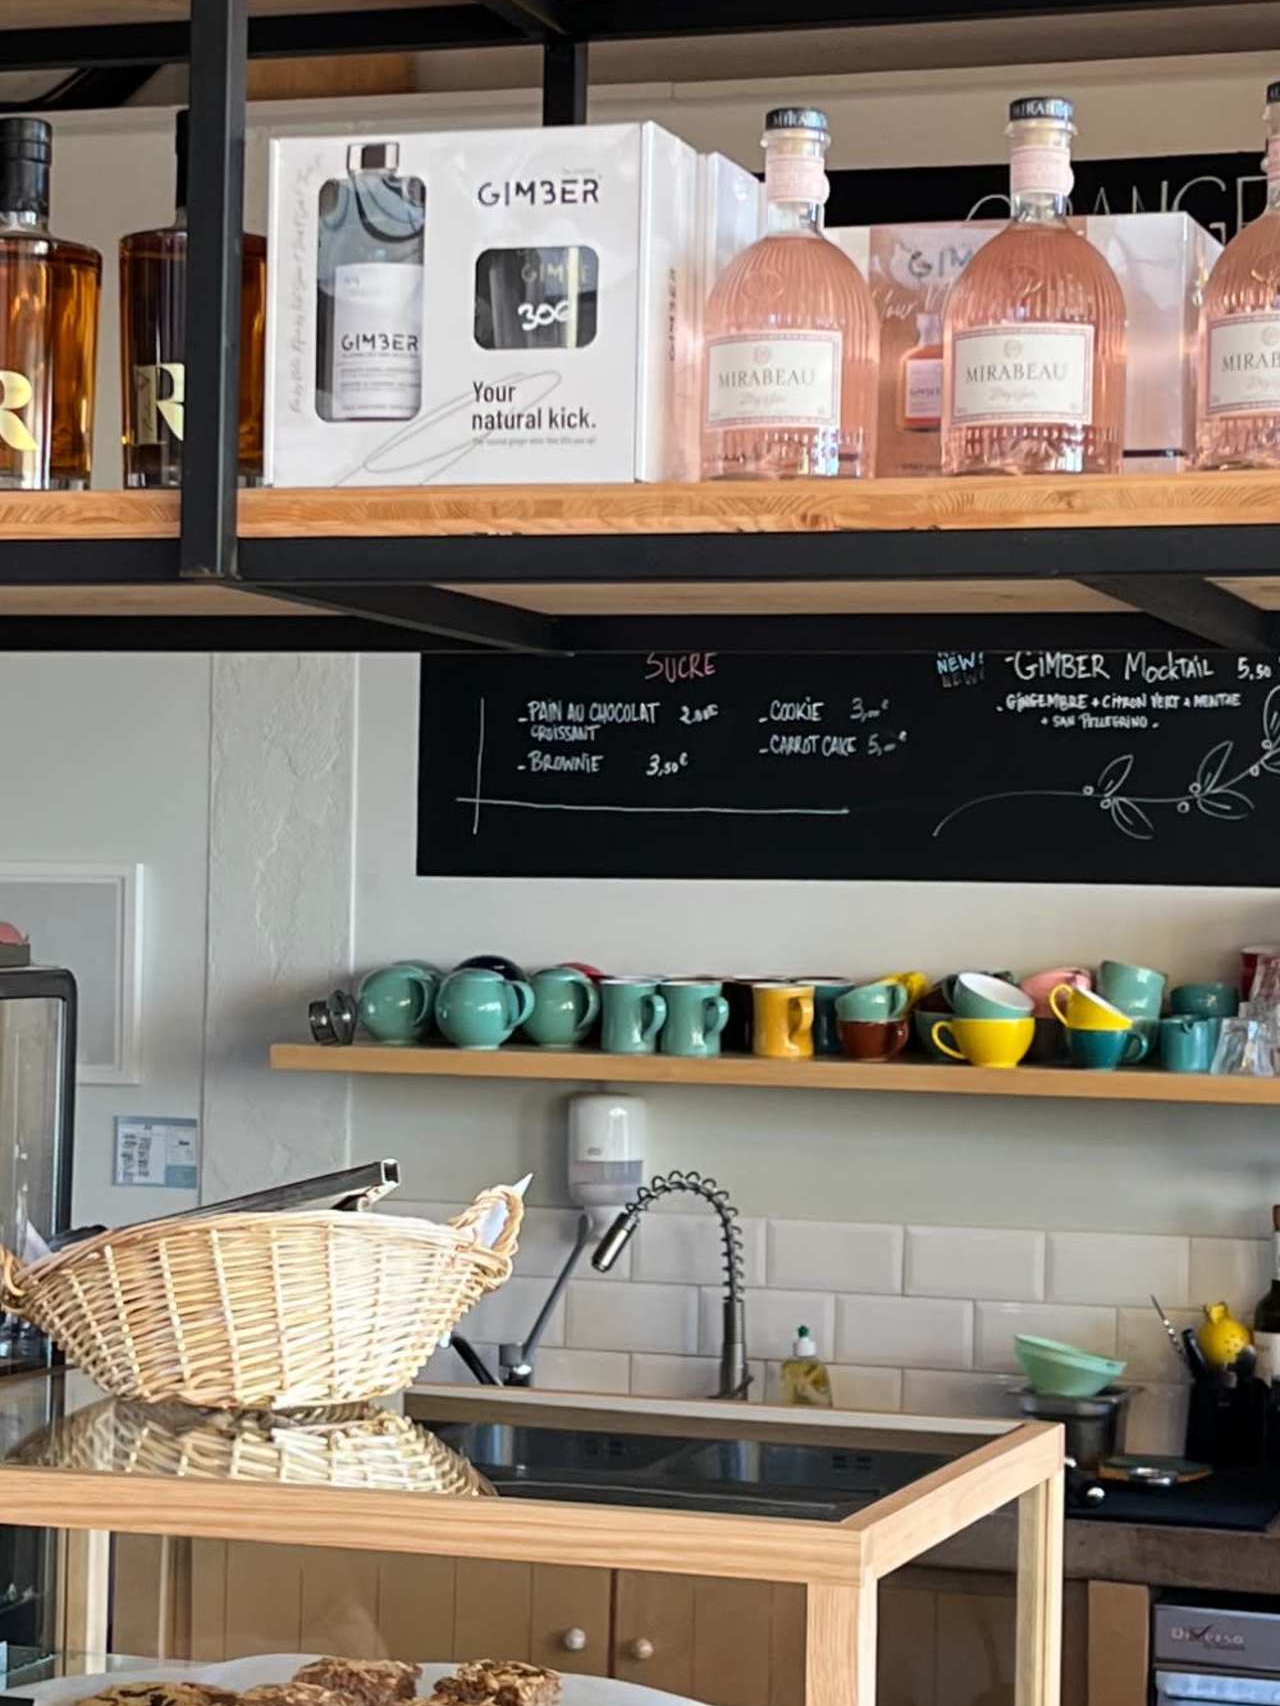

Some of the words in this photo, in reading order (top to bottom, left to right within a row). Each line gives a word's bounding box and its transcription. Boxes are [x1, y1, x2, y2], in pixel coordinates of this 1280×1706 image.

[718, 368, 818, 389] MIRABEAU
[966, 363, 1068, 383] MIRABEAU
[472, 380, 516, 404] Your
[471, 408, 543, 432] natural
[548, 406, 597, 431] kick.
[936, 652, 985, 675] NEW!
[527, 699, 562, 723] PAIN
[567, 702, 585, 723] AU
[589, 702, 661, 724] CHOCOLAT
[1005, 690, 1087, 714] GINGEMBRE
[1149, 690, 1180, 710] VERT
[530, 724, 602, 741] CROISSANT
[1052, 715, 1076, 728] SAN
[770, 735, 821, 756] CARROT
[821, 736, 857, 757] CAKE
[527, 750, 604, 774] BROWNIE
